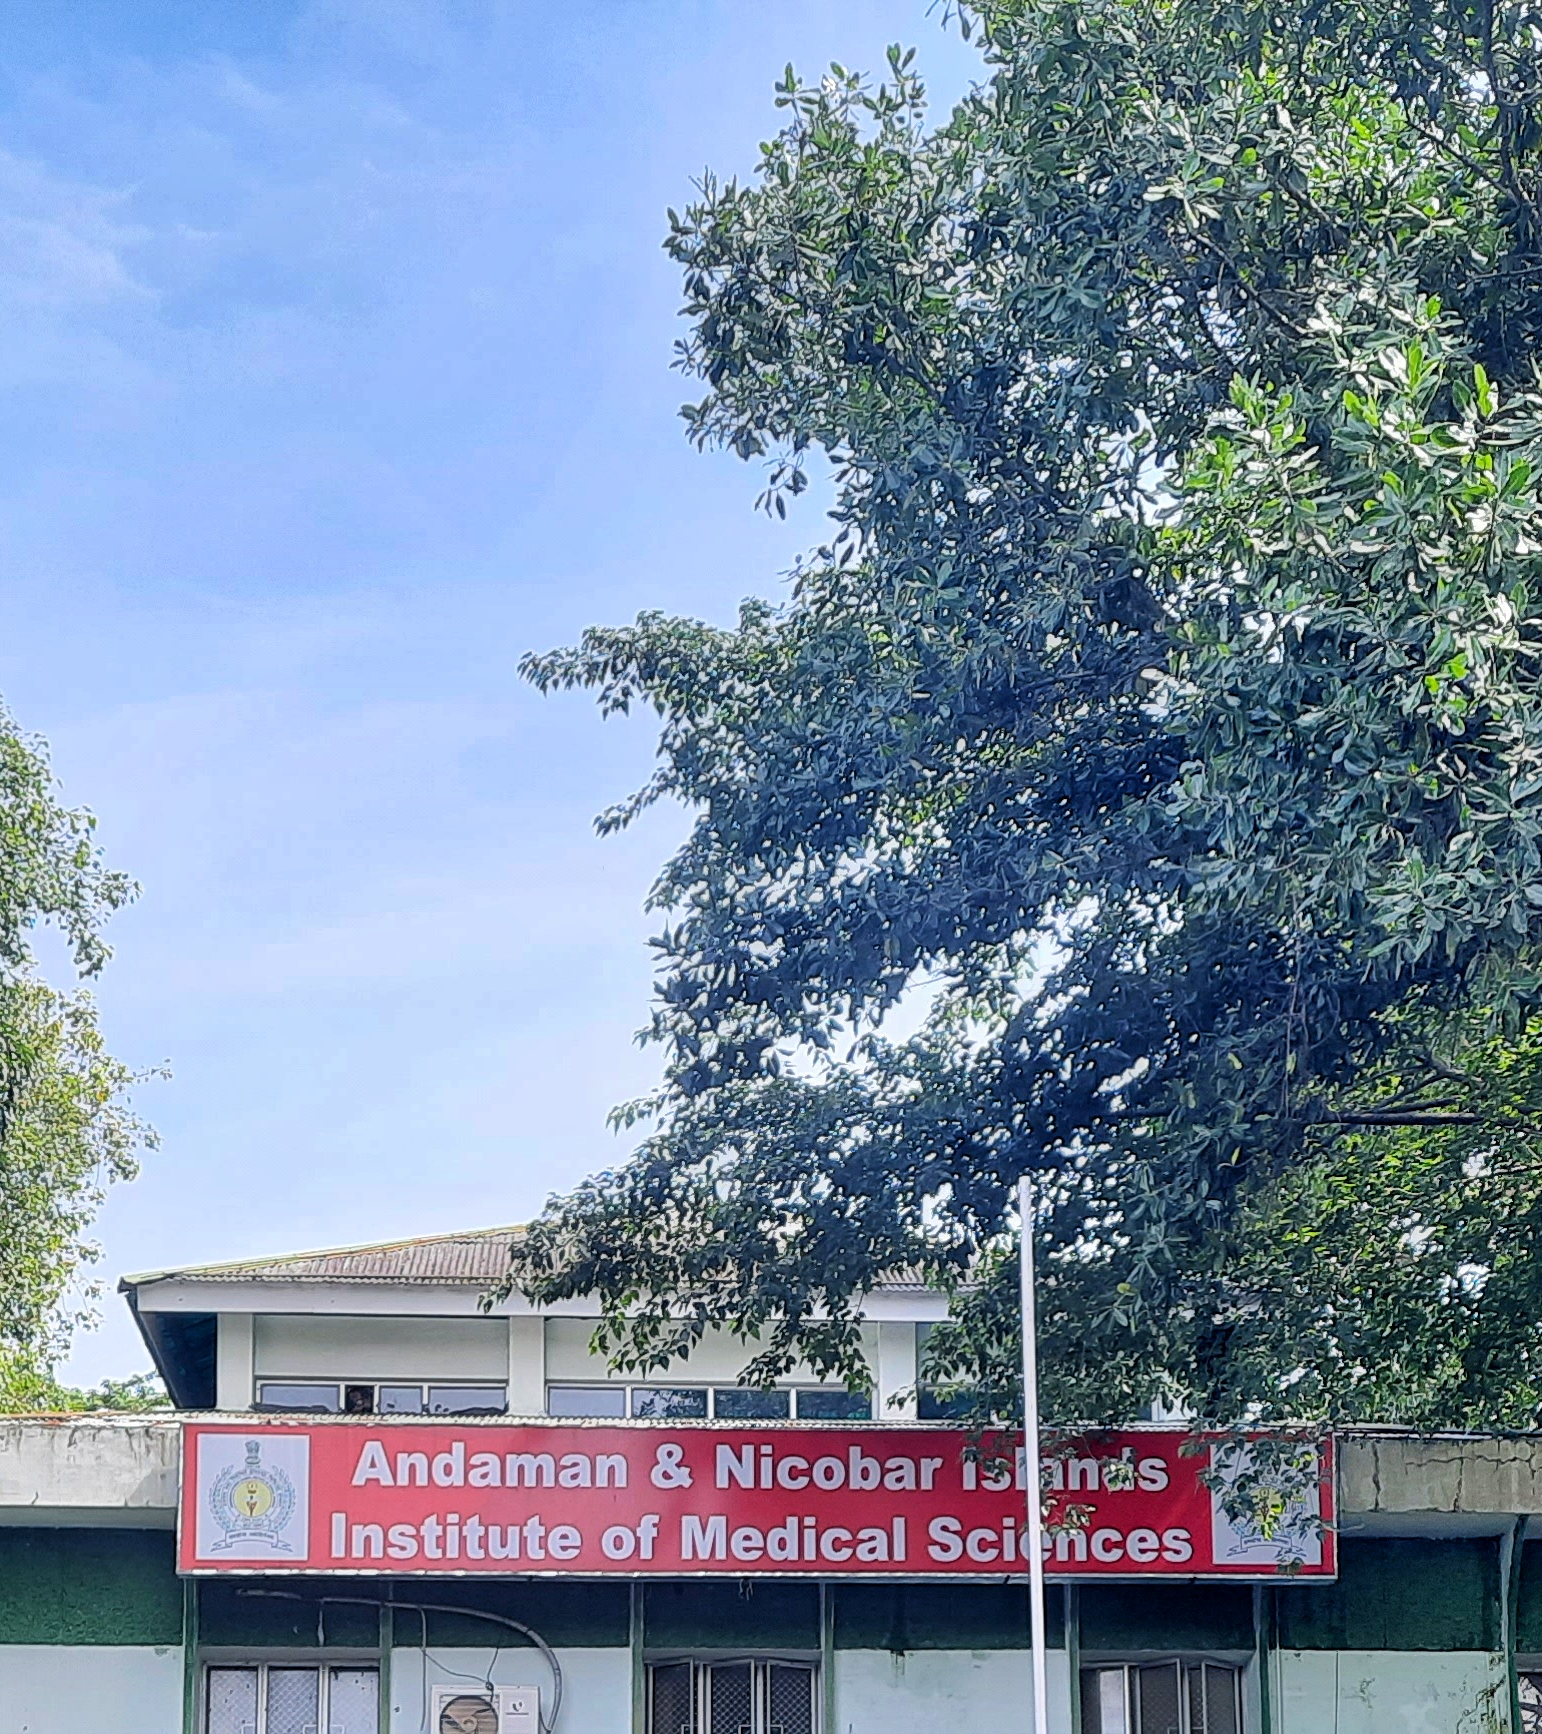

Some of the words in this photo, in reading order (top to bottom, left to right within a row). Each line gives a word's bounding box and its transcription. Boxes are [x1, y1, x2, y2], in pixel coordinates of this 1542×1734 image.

[352, 1440, 627, 1489] Andaman
[651, 1442, 693, 1489] &
[715, 1444, 943, 1491] Nicobar
[330, 1512, 582, 1560] Institute
[601, 1512, 661, 1561] of
[681, 1516, 906, 1562] Medical
[927, 1516, 1193, 1563] Sciences
